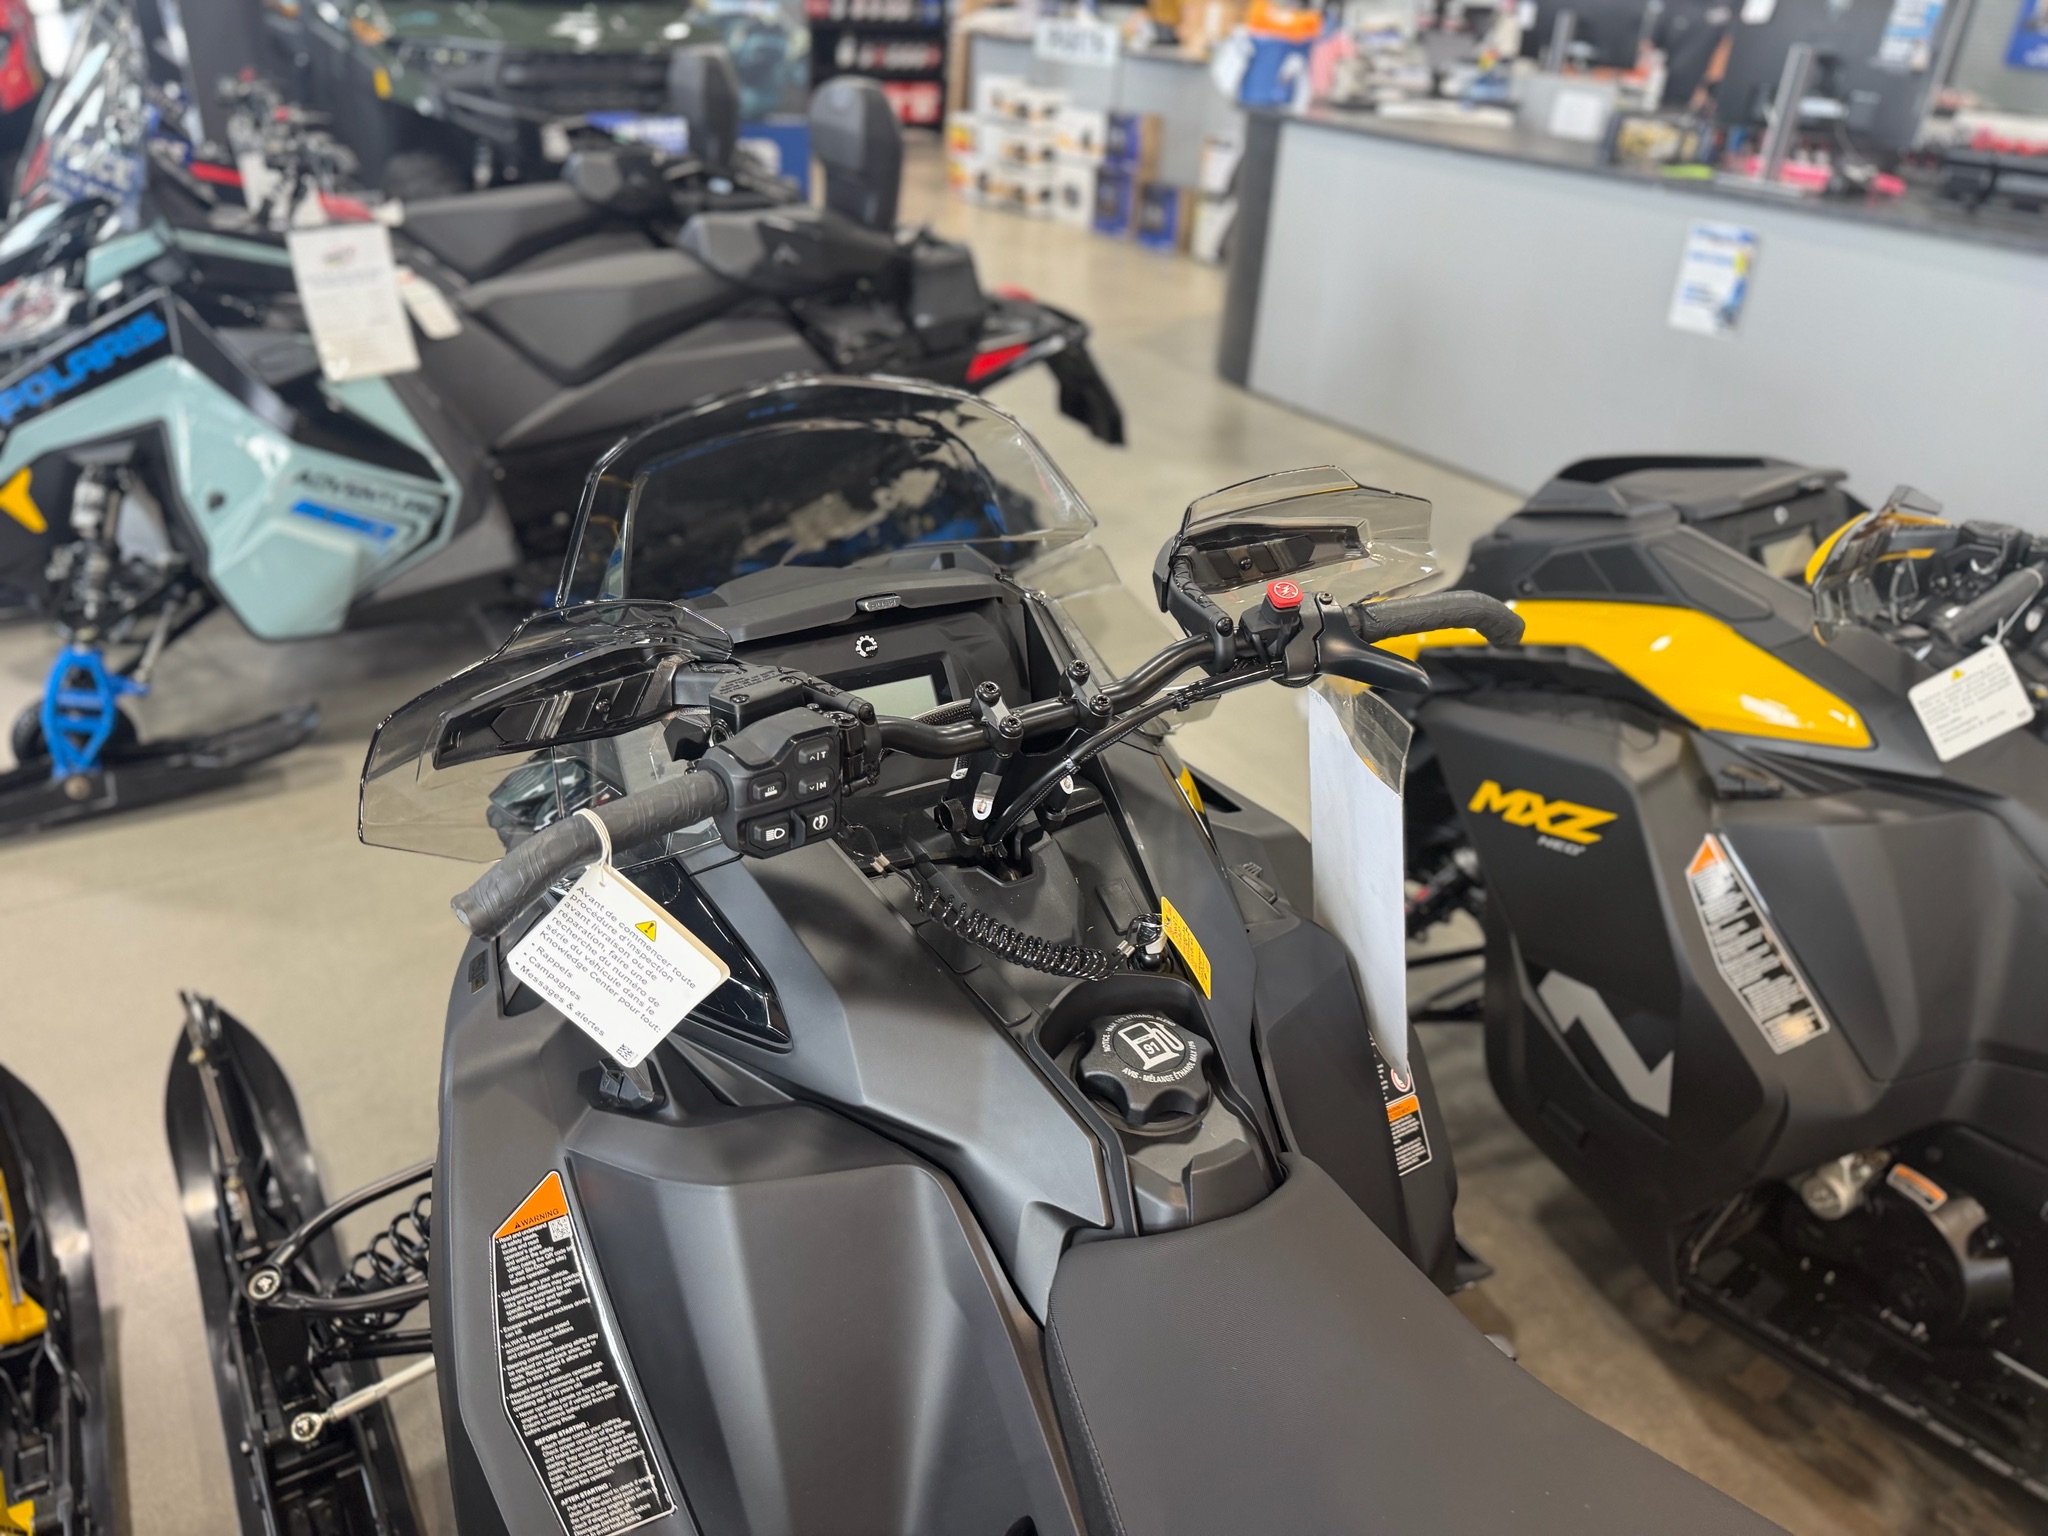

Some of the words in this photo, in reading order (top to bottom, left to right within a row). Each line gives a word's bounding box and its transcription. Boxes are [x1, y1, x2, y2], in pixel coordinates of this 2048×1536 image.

[1468, 779, 1618, 844] MXZ
[536, 946, 572, 978] Rappels
[546, 924, 568, 944] série
[570, 944, 582, 956] du
[585, 955, 621, 987] véhicule
[622, 987, 644, 1007] dans
[645, 1006, 655, 1015] le
[552, 917, 597, 955] recherche
[598, 955, 611, 967] du
[612, 967, 646, 996] numéro
[648, 996, 660, 1007] de
[558, 909, 605, 952] réparation,
[608, 950, 629, 969] faire
[630, 969, 647, 985] une
[564, 901, 590, 924] avant
[591, 923, 630, 958] livraison
[631, 958, 644, 970] ou
[645, 969, 657, 981] de
[569, 894, 617, 934] procédure
[619, 935, 673, 982] d'inspection
[576, 886, 604, 911] Avant
[605, 910, 617, 922] de
[619, 922, 671, 967] commencer
[672, 967, 695, 989] toute
[520, 965, 564, 1003] Messages
[566, 1002, 574, 1010] &
[575, 1011, 604, 1036] alertes
[529, 956, 580, 1000] Campagnes
[540, 930, 588, 972] Knowledge
[589, 971, 618, 996] Center
[617, 996, 640, 1014] pour
[640, 1014, 661, 1033] tout:
[1102, 1035, 1111, 1052] NOTICE
[1122, 1068, 1139, 1078] AVIS
[1143, 1074, 1175, 1083] MÉLANGE
[1143, 1041, 1160, 1055] 91
[520, 1208, 559, 1225] WARNING
